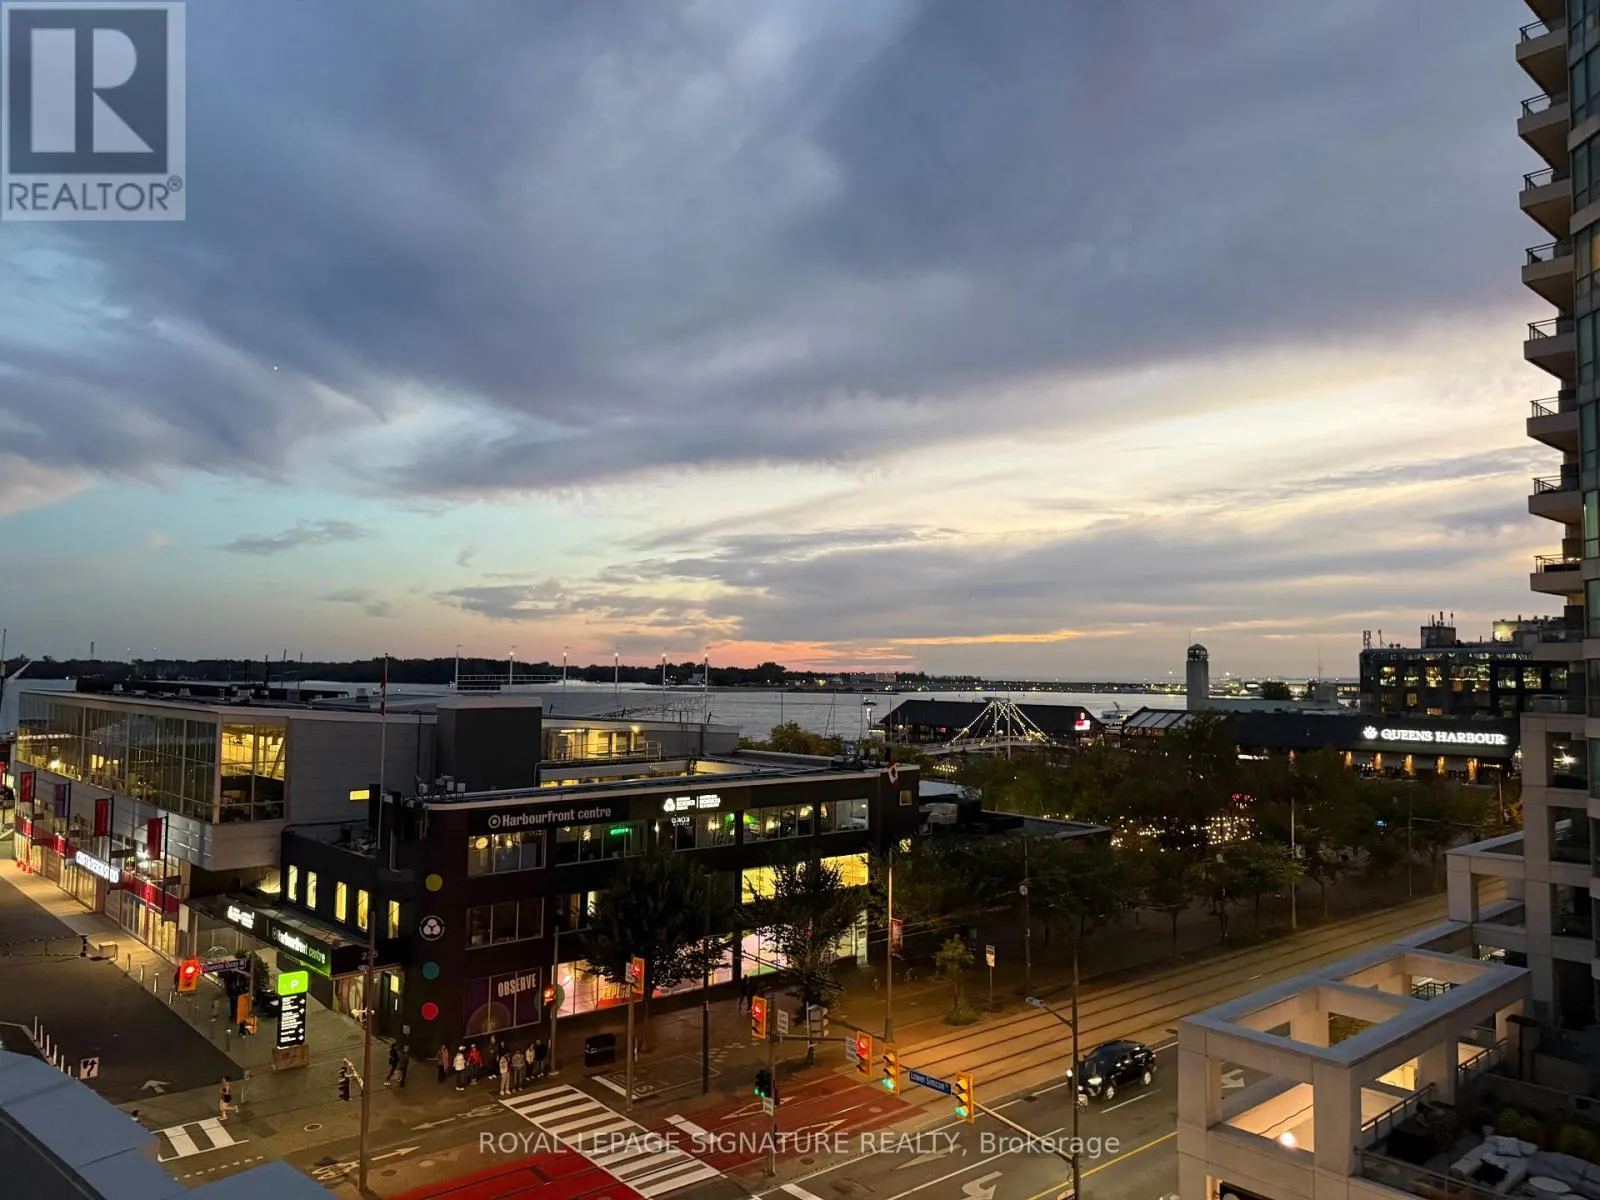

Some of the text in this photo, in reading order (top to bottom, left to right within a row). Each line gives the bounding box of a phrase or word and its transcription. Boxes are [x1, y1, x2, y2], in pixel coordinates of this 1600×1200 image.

[1381, 729, 1508, 745] QUEENS HARBOUR
[502, 806, 612, 827] Harbourfront centre
[498, 973, 537, 997] OBSERVE
[911, 1072, 926, 1083] Lower
[926, 1076, 945, 1090] Simcoe
